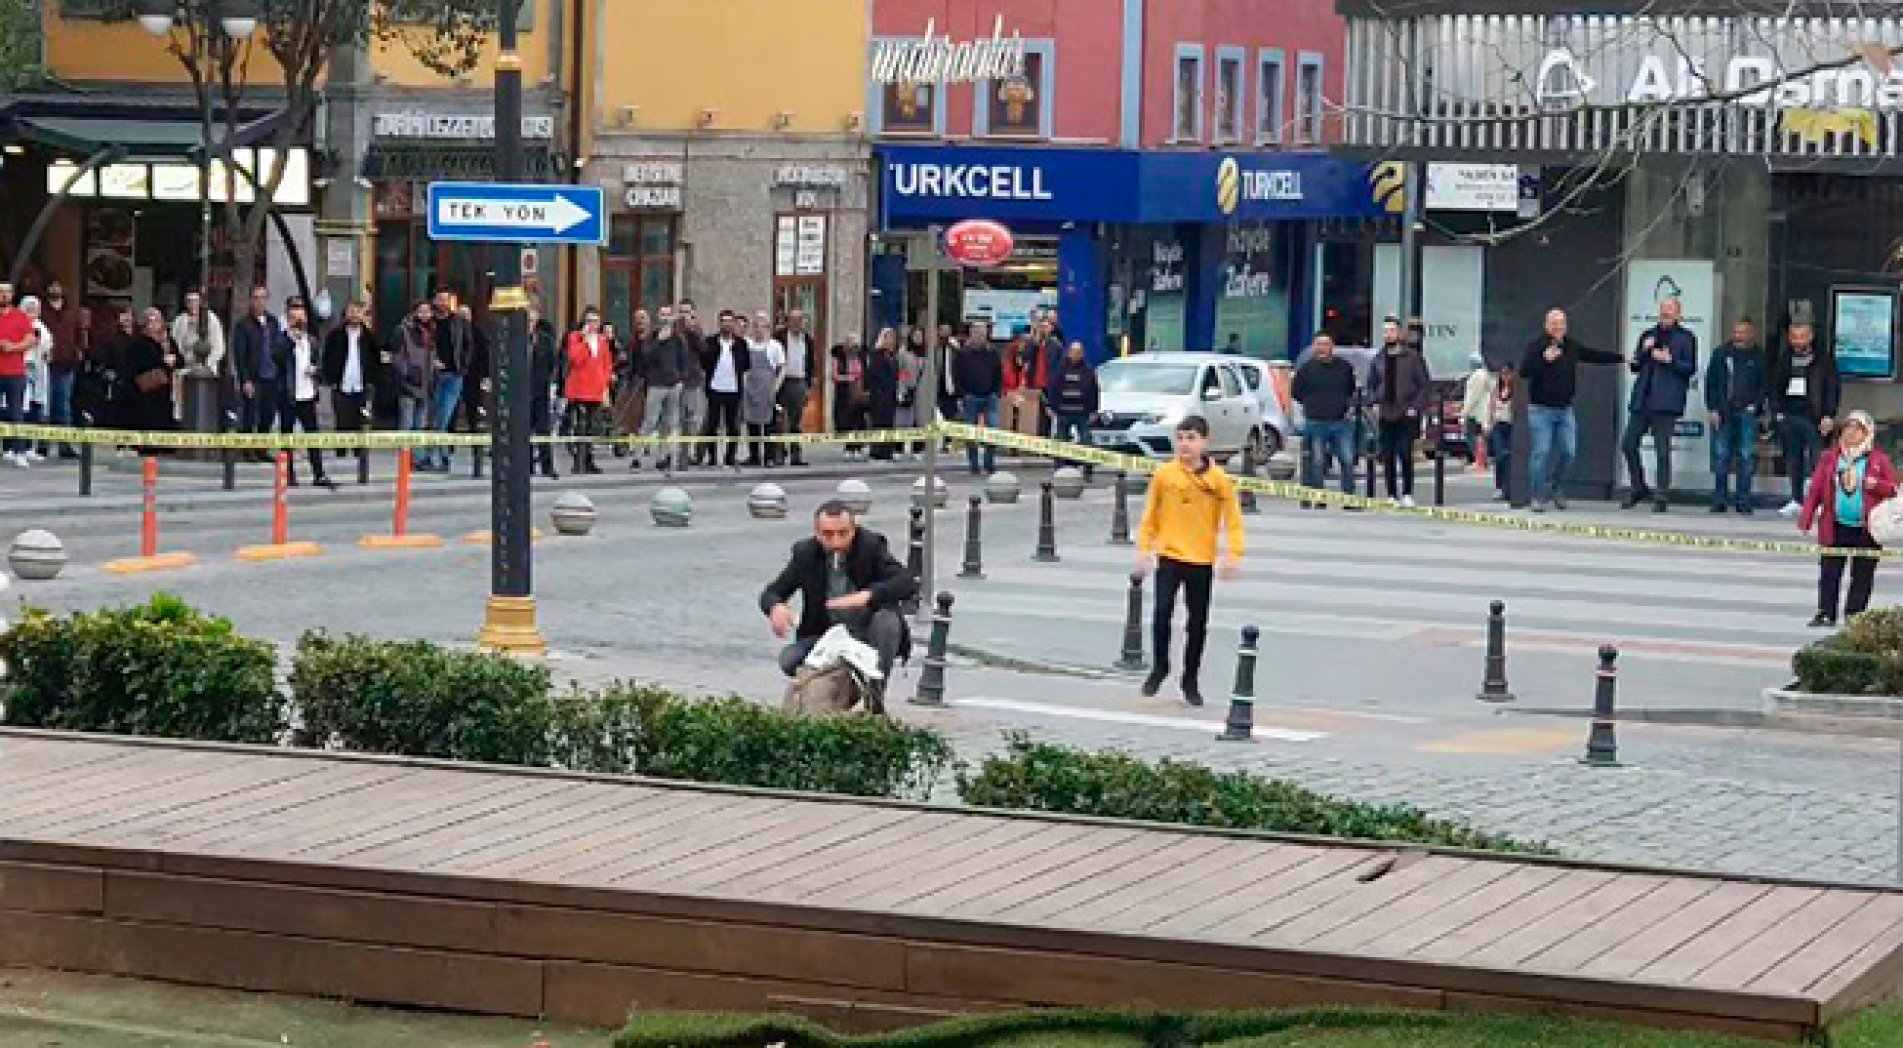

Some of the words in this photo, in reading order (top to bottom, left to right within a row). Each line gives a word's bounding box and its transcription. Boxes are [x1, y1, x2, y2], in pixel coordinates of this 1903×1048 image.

[890, 163, 1053, 199] URKCELL
[450, 204, 486, 218] TEK
[503, 204, 546, 221] YÖN
